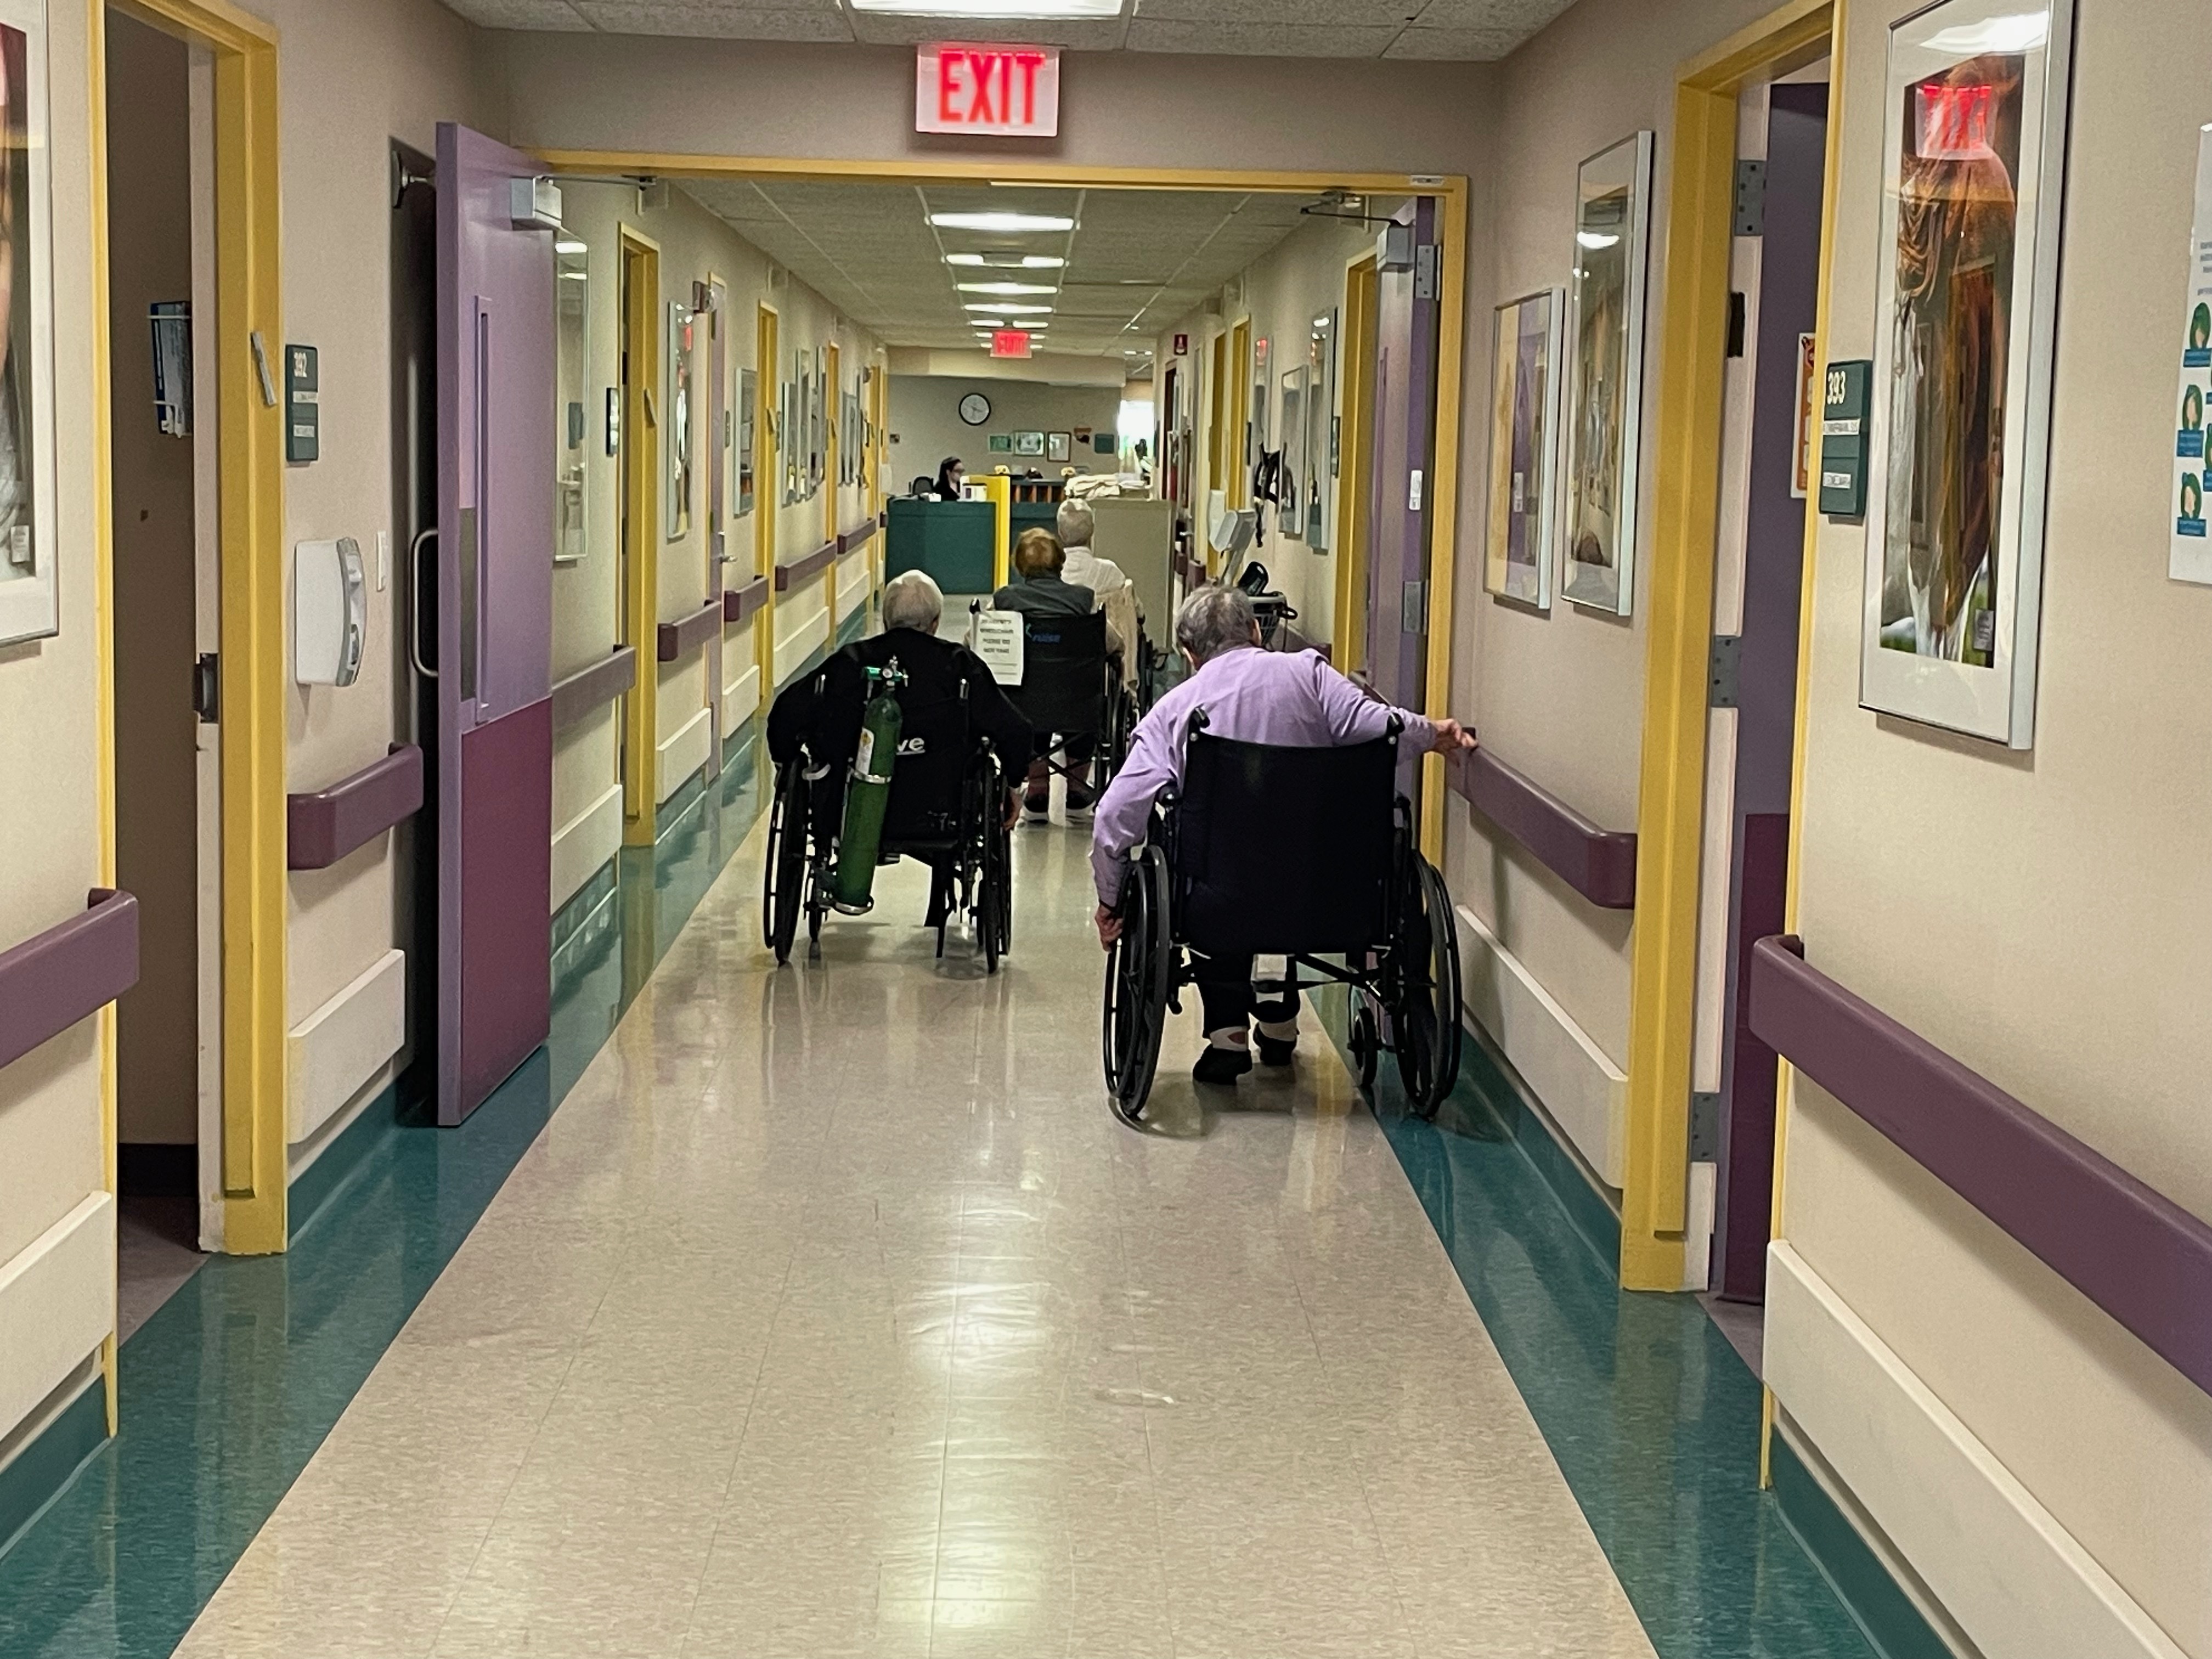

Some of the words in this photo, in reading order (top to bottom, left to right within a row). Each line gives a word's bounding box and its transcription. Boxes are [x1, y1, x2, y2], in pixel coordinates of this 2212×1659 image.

[939, 49, 1045, 124] EXIT
[1827, 371, 1846, 404] 393
[896, 737, 925, 753] ve
